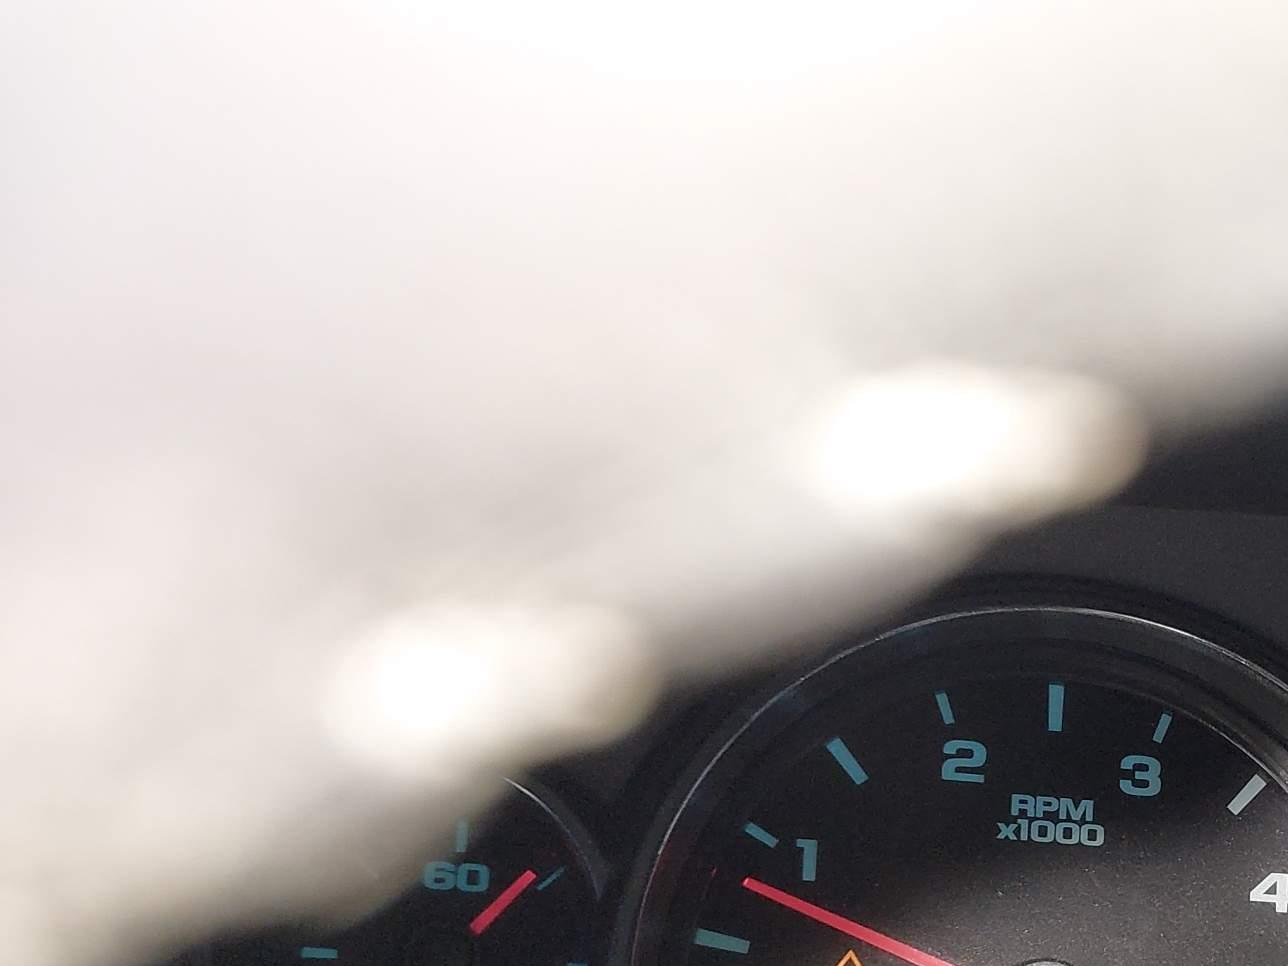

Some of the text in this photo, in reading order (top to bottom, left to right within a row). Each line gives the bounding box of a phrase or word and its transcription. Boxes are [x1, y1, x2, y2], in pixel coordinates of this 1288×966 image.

[941, 740, 988, 783] 2
[1120, 755, 1163, 797] 3
[1010, 794, 1094, 822] RPM
[996, 821, 1105, 847] x1000
[423, 860, 491, 894] 60
[796, 838, 819, 883] 1
